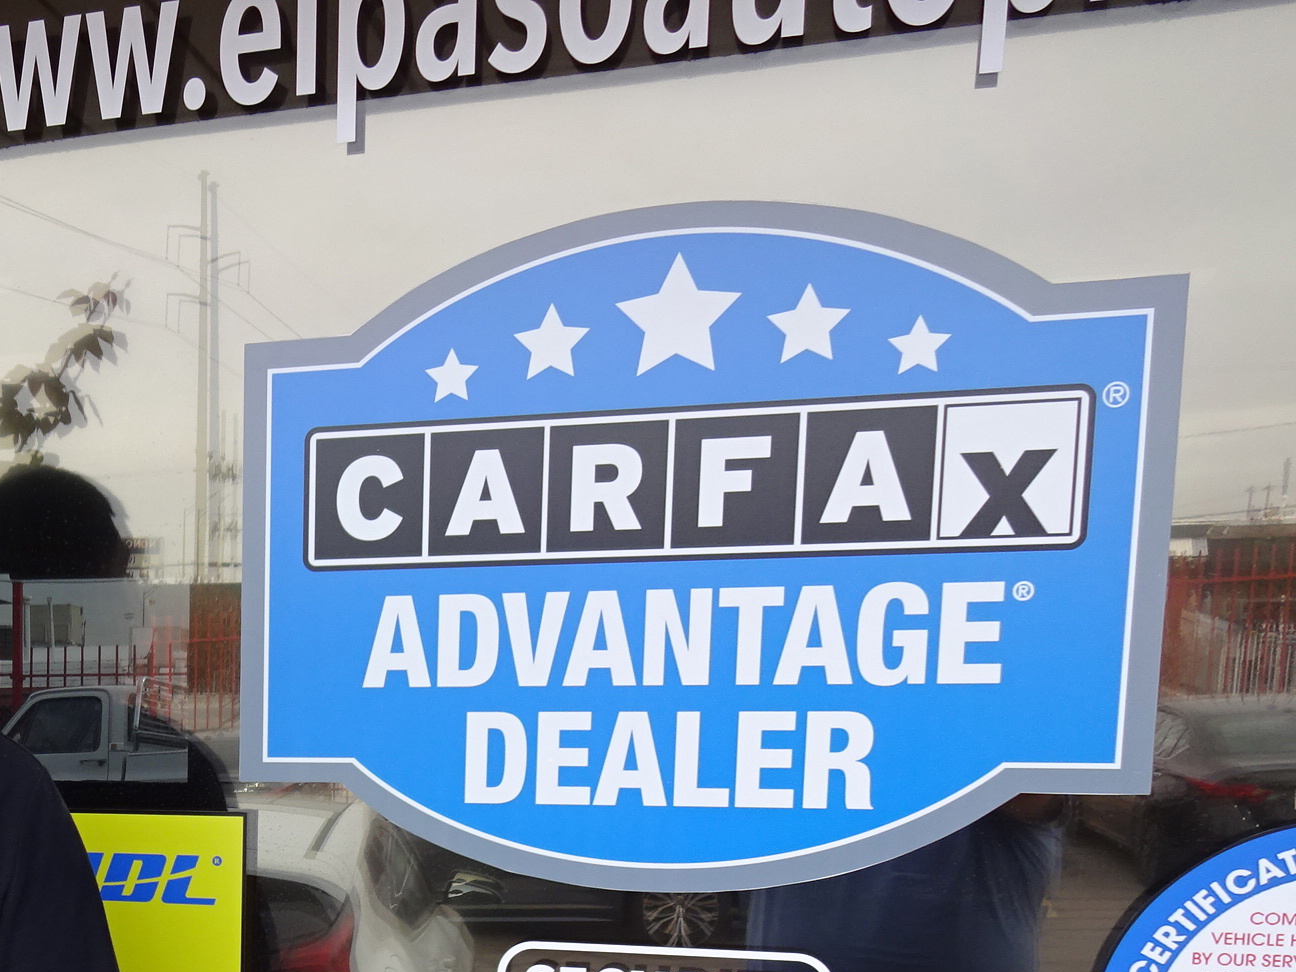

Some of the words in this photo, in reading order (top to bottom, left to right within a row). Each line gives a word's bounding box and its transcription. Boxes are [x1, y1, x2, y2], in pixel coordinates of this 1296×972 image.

[335, 429, 1059, 542] CARFAX
[362, 581, 1006, 688] ADVANTAGE
[464, 710, 874, 810] DEALER
[1192, 952, 1213, 966] BY
[1217, 952, 1257, 967] OUR
[1261, 953, 1296, 968] SER
[1211, 932, 1285, 947] VEHICLE
